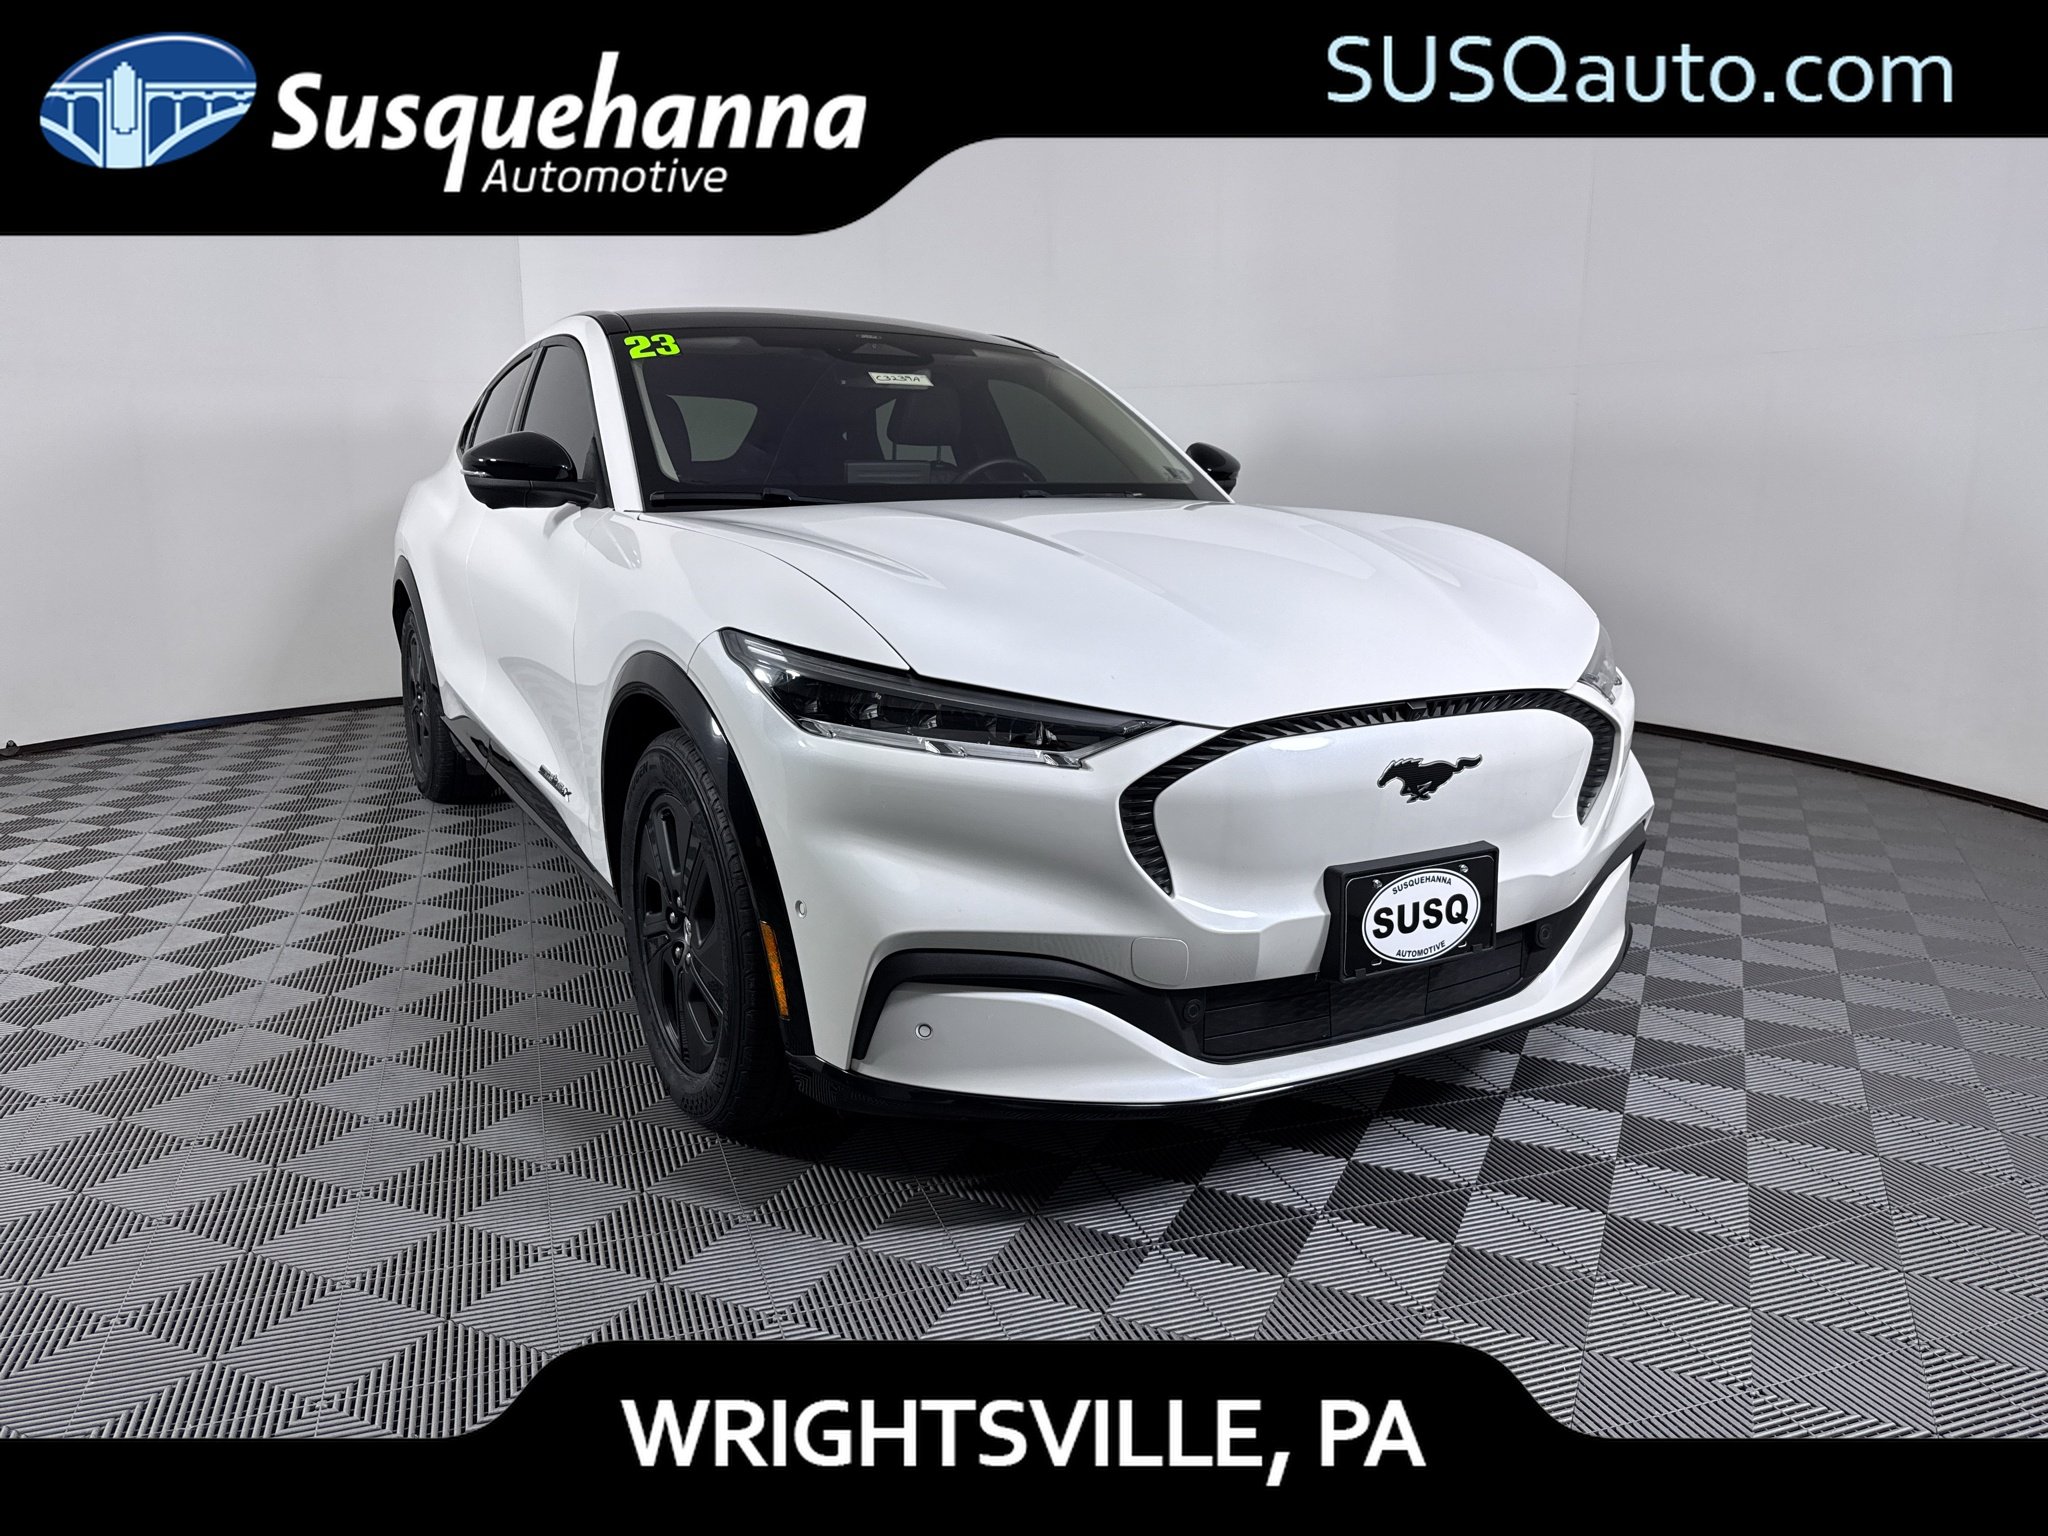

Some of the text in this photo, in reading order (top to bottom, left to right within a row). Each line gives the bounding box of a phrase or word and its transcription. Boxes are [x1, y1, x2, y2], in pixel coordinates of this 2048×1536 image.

[623, 333, 681, 360] 23
[1392, 875, 1453, 895] SUSQUEHANNA
[1372, 893, 1469, 939] SUSQ
[1396, 940, 1446, 958] AUTOMOTIVE
